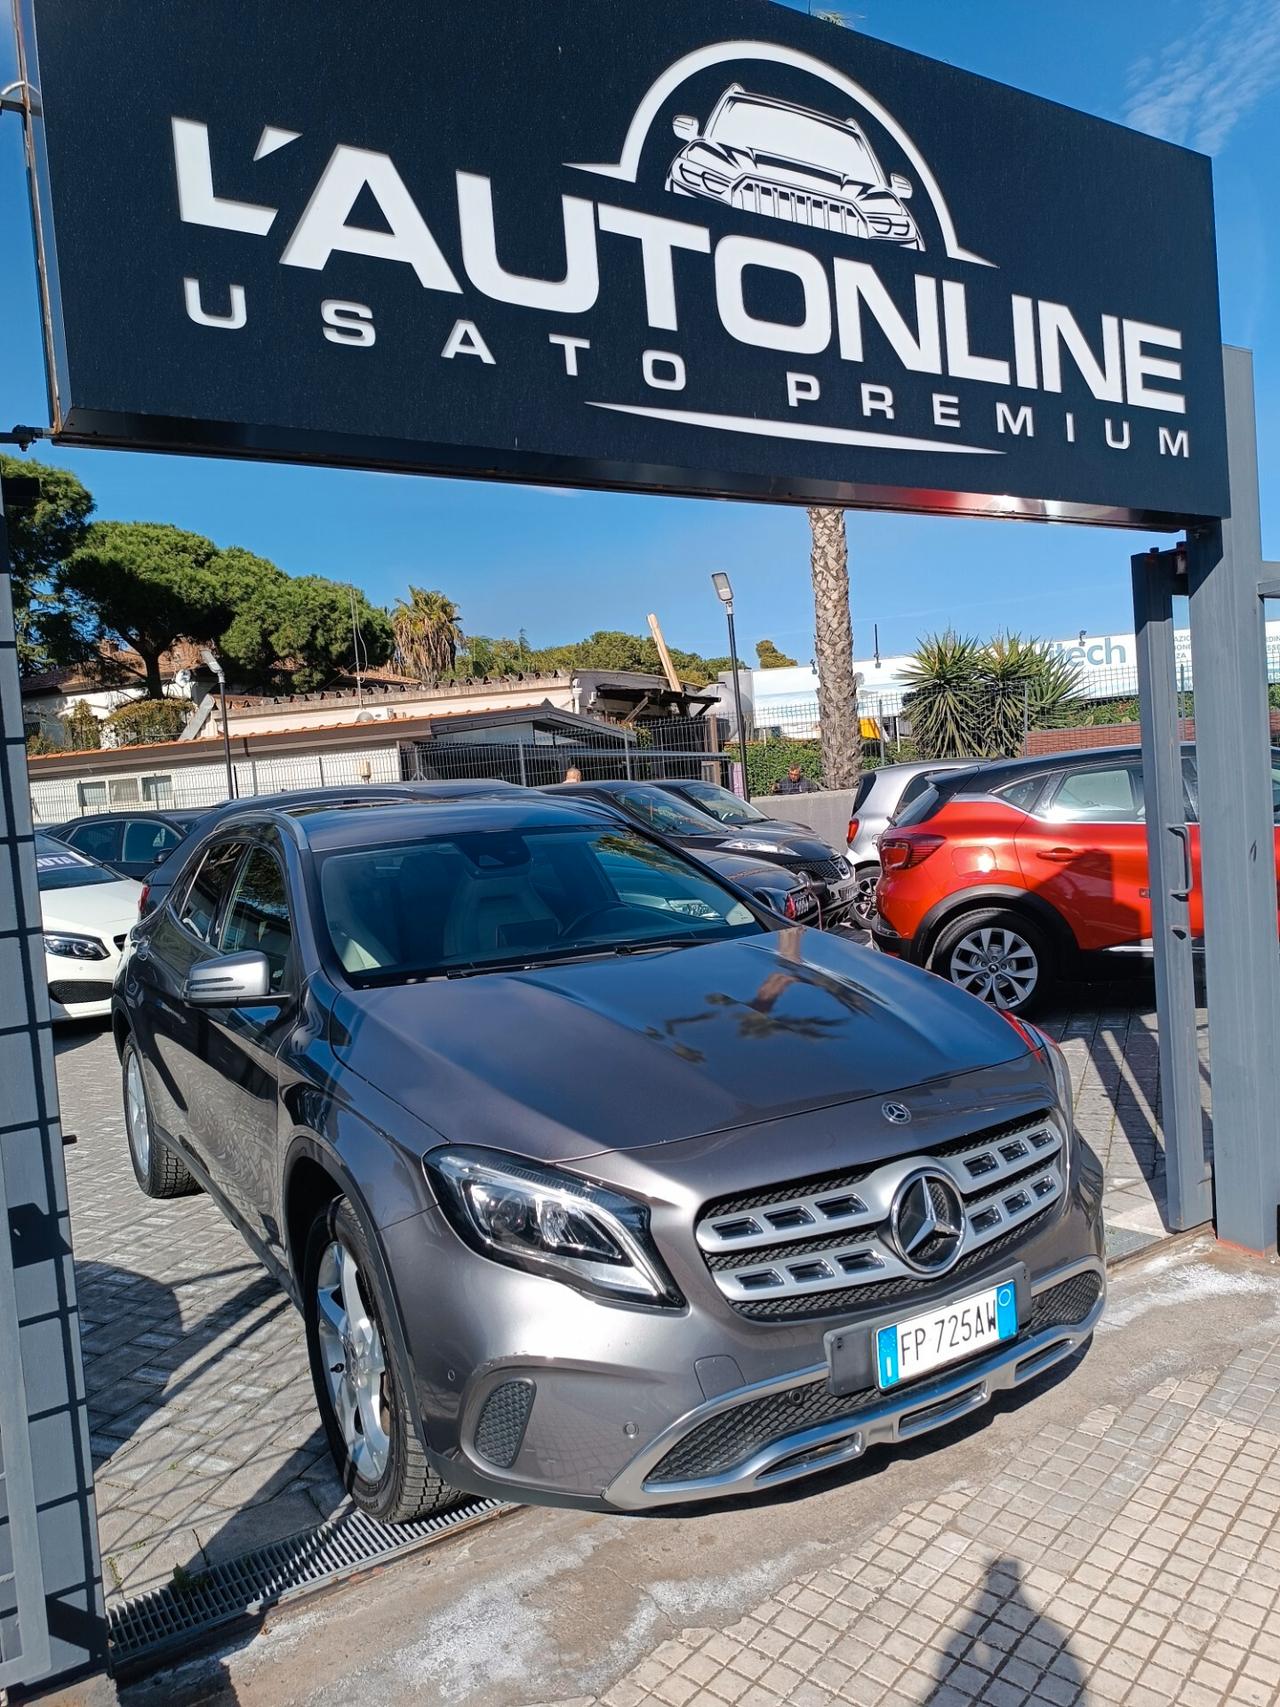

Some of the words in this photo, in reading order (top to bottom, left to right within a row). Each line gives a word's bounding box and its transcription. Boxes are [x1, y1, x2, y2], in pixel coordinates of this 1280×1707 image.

[170, 116, 1186, 414] L'AUTONLINE
[183, 278, 686, 391] USATO
[786, 372, 1189, 458] PREMIUM
[900, 1327, 927, 1366] FP
